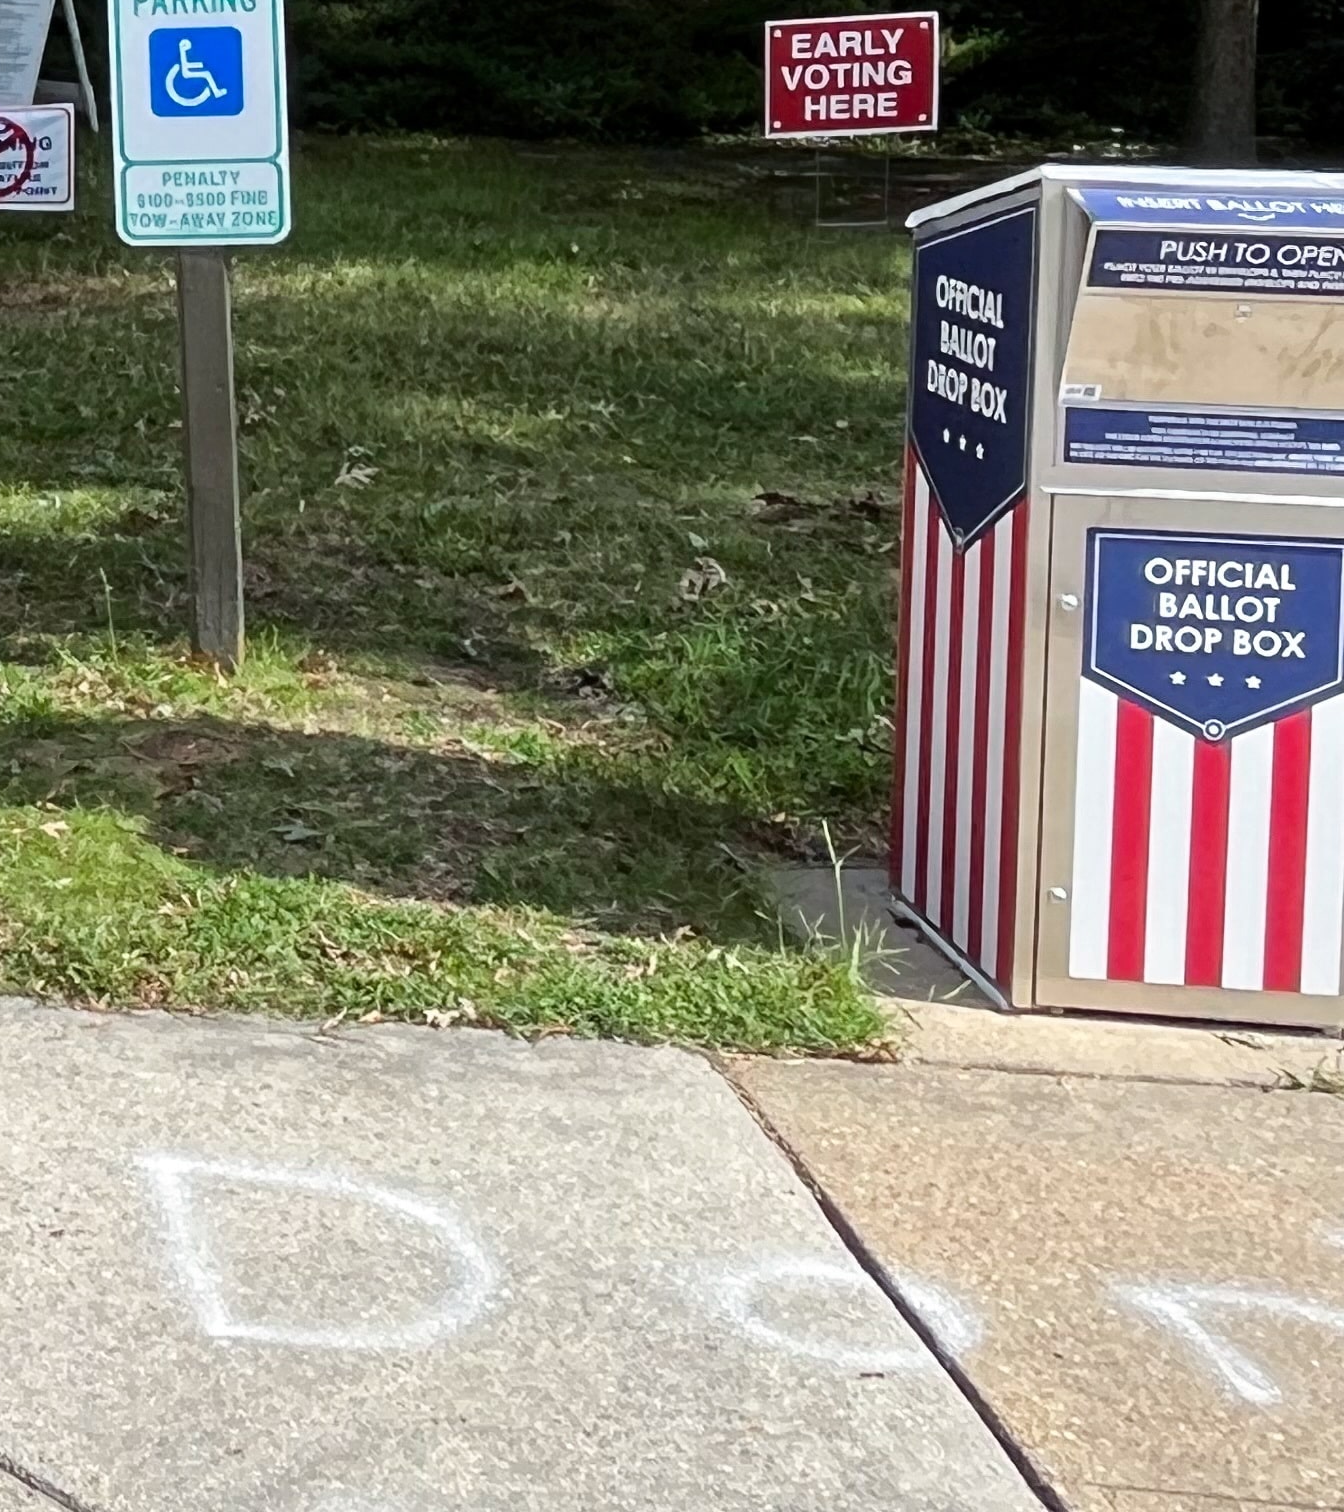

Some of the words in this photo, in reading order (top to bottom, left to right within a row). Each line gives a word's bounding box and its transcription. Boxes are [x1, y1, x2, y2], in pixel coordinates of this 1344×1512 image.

[791, 28, 904, 59] EARLY
[781, 59, 912, 91] VOTING
[804, 91, 898, 121] HERE
[162, 170, 240, 187] PENALTY
[230, 190, 268, 206] FINE
[1206, 199, 1307, 214] BALLOT
[129, 212, 226, 230] TOW-AWAY
[231, 210, 277, 228] ZONE
[1159, 240, 1229, 262] PUSH
[1233, 243, 1271, 265] TO
[936, 274, 1004, 329] OFFICIAL
[940, 320, 997, 372] BALLOT
[927, 359, 968, 405] DROP
[970, 377, 1008, 425] BOX
[1144, 557, 1297, 591] OFFICIAL
[1159, 592, 1281, 623] BALLOT
[1130, 623, 1223, 654] DROP
[1233, 628, 1306, 659] BOX
